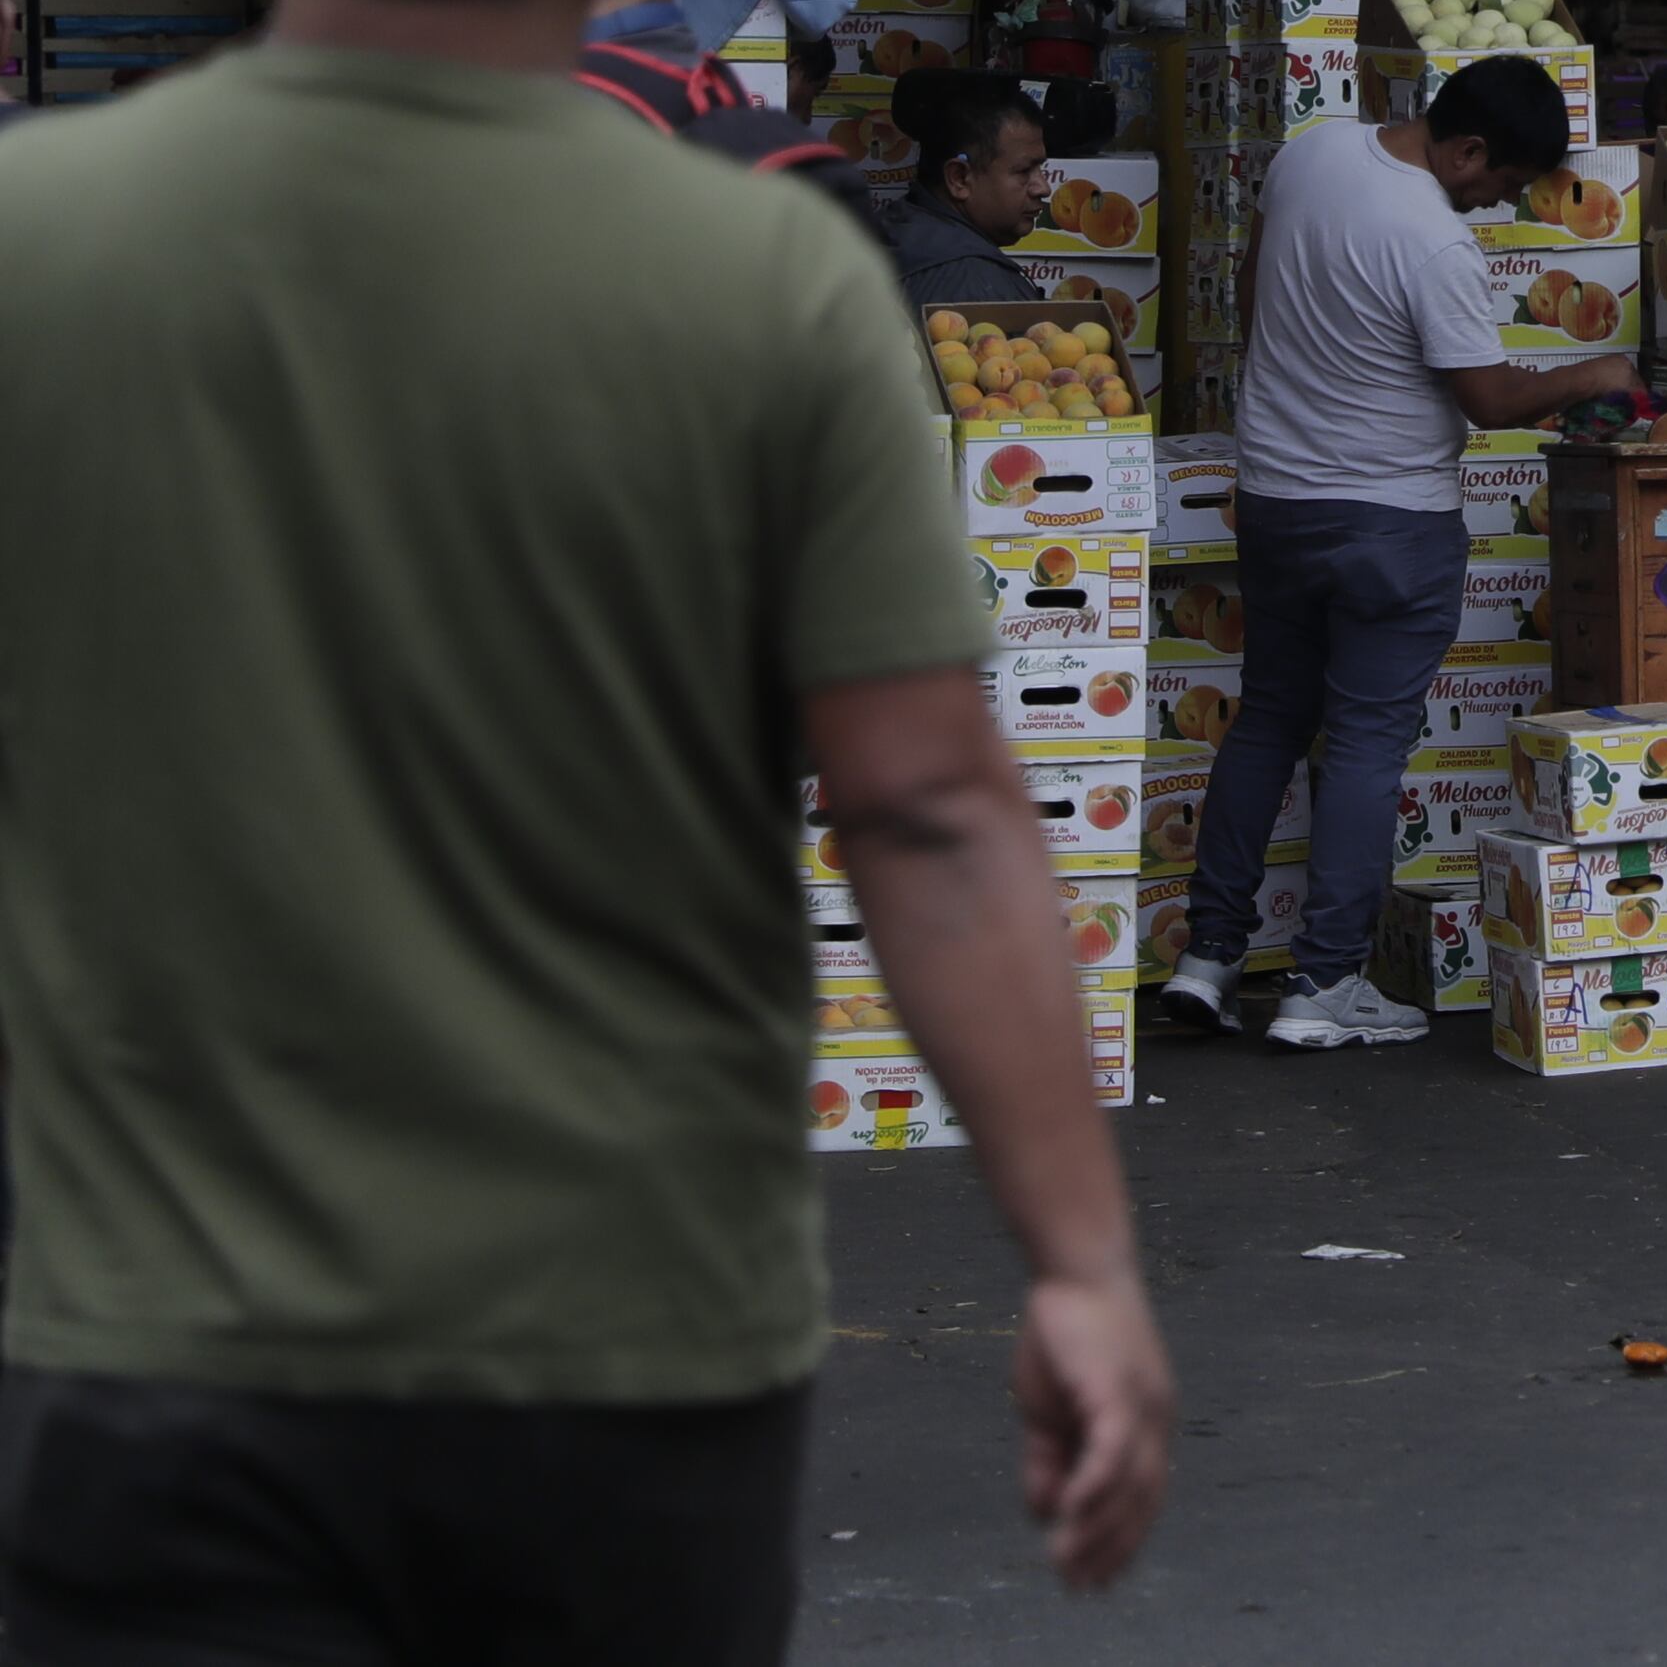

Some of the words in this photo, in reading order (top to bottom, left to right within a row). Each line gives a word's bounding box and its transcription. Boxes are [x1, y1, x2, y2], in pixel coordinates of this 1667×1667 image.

[827, 14, 886, 33] cotón
[1169, 464, 1238, 482] MELOCOTÓN
[1461, 463, 1546, 487] locotón
[1461, 489, 1510, 505] Huayco
[1025, 507, 1104, 527] MELOCOTÓN
[1112, 569, 1139, 577] Puesto
[1464, 569, 1550, 594] locotón
[1463, 596, 1513, 610] Huayco
[1429, 675, 1546, 699] Melocotón
[1460, 700, 1511, 715] Huayco
[1026, 712, 1060, 721] Calidad
[1063, 712, 1074, 721] de
[1015, 720, 1085, 731] EXPORTACIÓN
[1141, 774, 1209, 801] ELOCOT
[1430, 780, 1509, 803] Meloco
[1460, 805, 1511, 820] Huayco
[1435, 863, 1479, 872] EXPORTAC
[1553, 912, 1581, 921] Puesto
[1556, 922, 1578, 936] 192
[1549, 1027, 1576, 1036] Puesto
[1549, 1039, 1569, 1051] 192
[881, 1076, 916, 1084] Calidad
